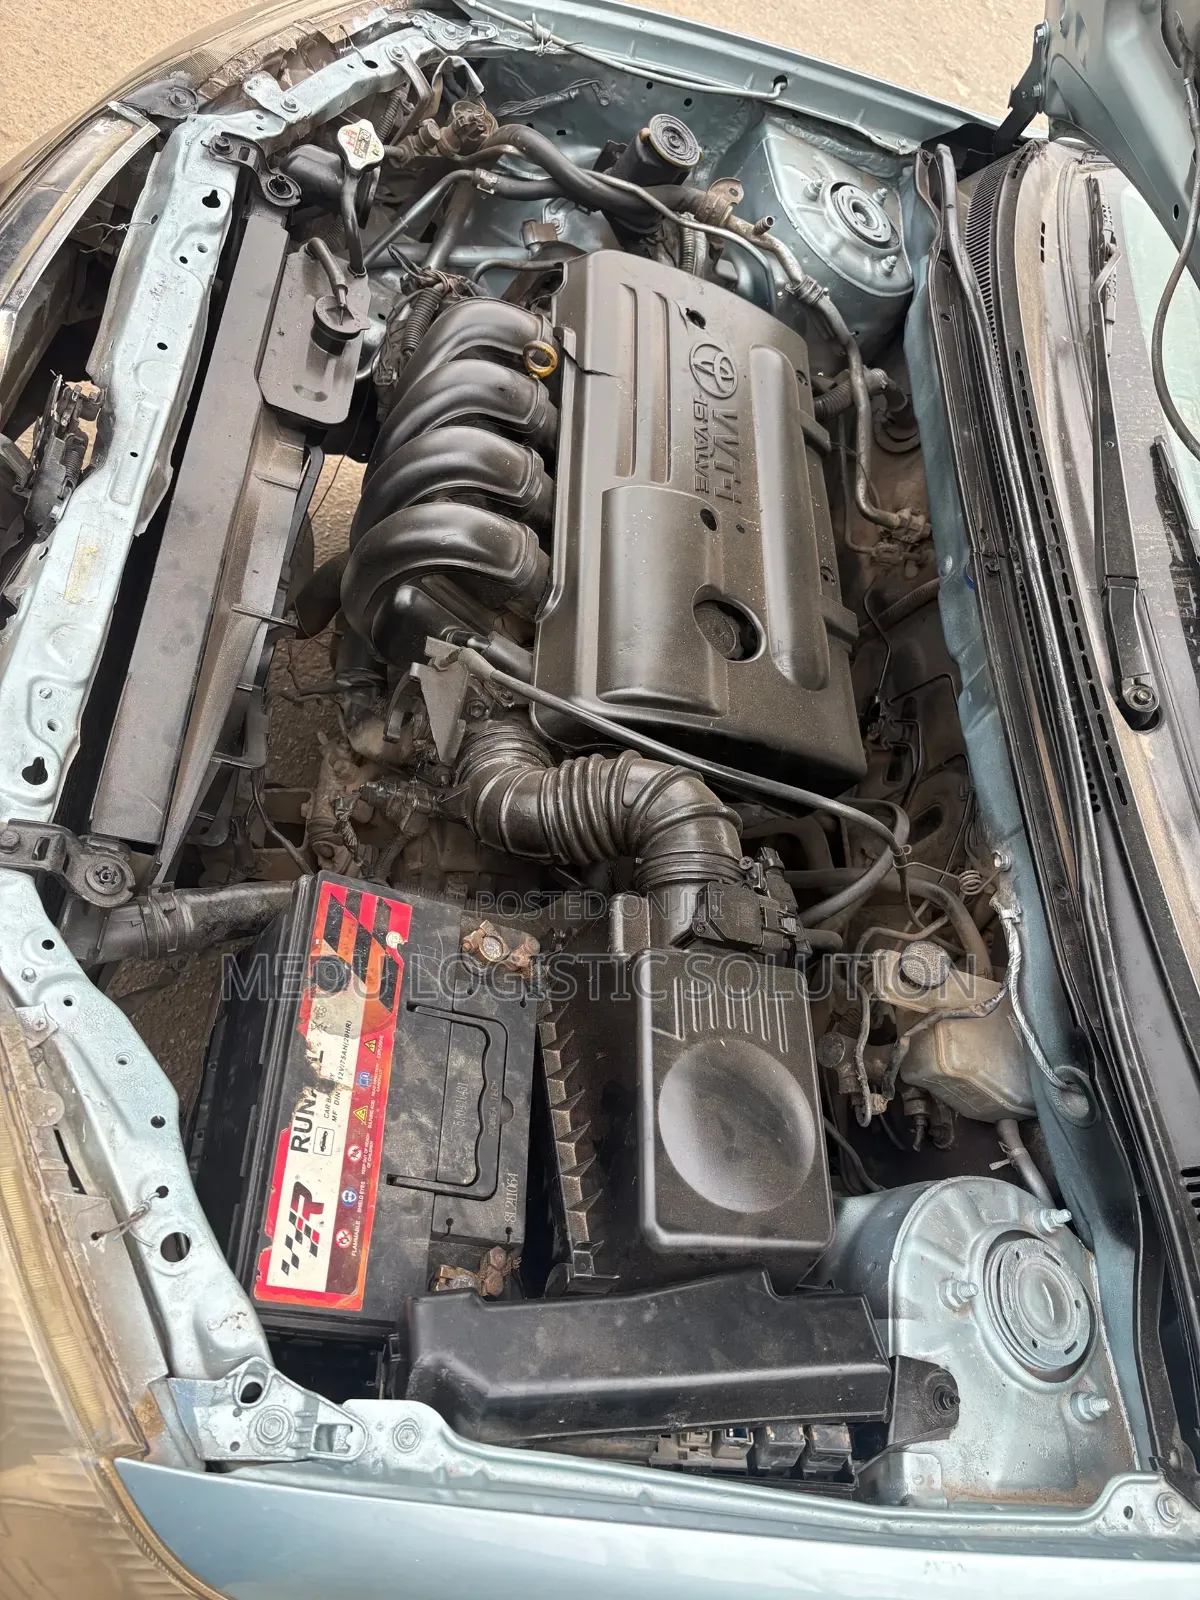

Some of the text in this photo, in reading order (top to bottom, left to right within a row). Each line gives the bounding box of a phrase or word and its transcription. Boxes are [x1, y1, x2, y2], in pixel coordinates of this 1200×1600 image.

[694, 424, 709, 494] VALVE
[323, 1104, 331, 1119] CAR
[331, 1110, 338, 1122] MF
[357, 1196, 365, 1213] SHIELD
[351, 1220, 361, 1257] FLAMMABLE
